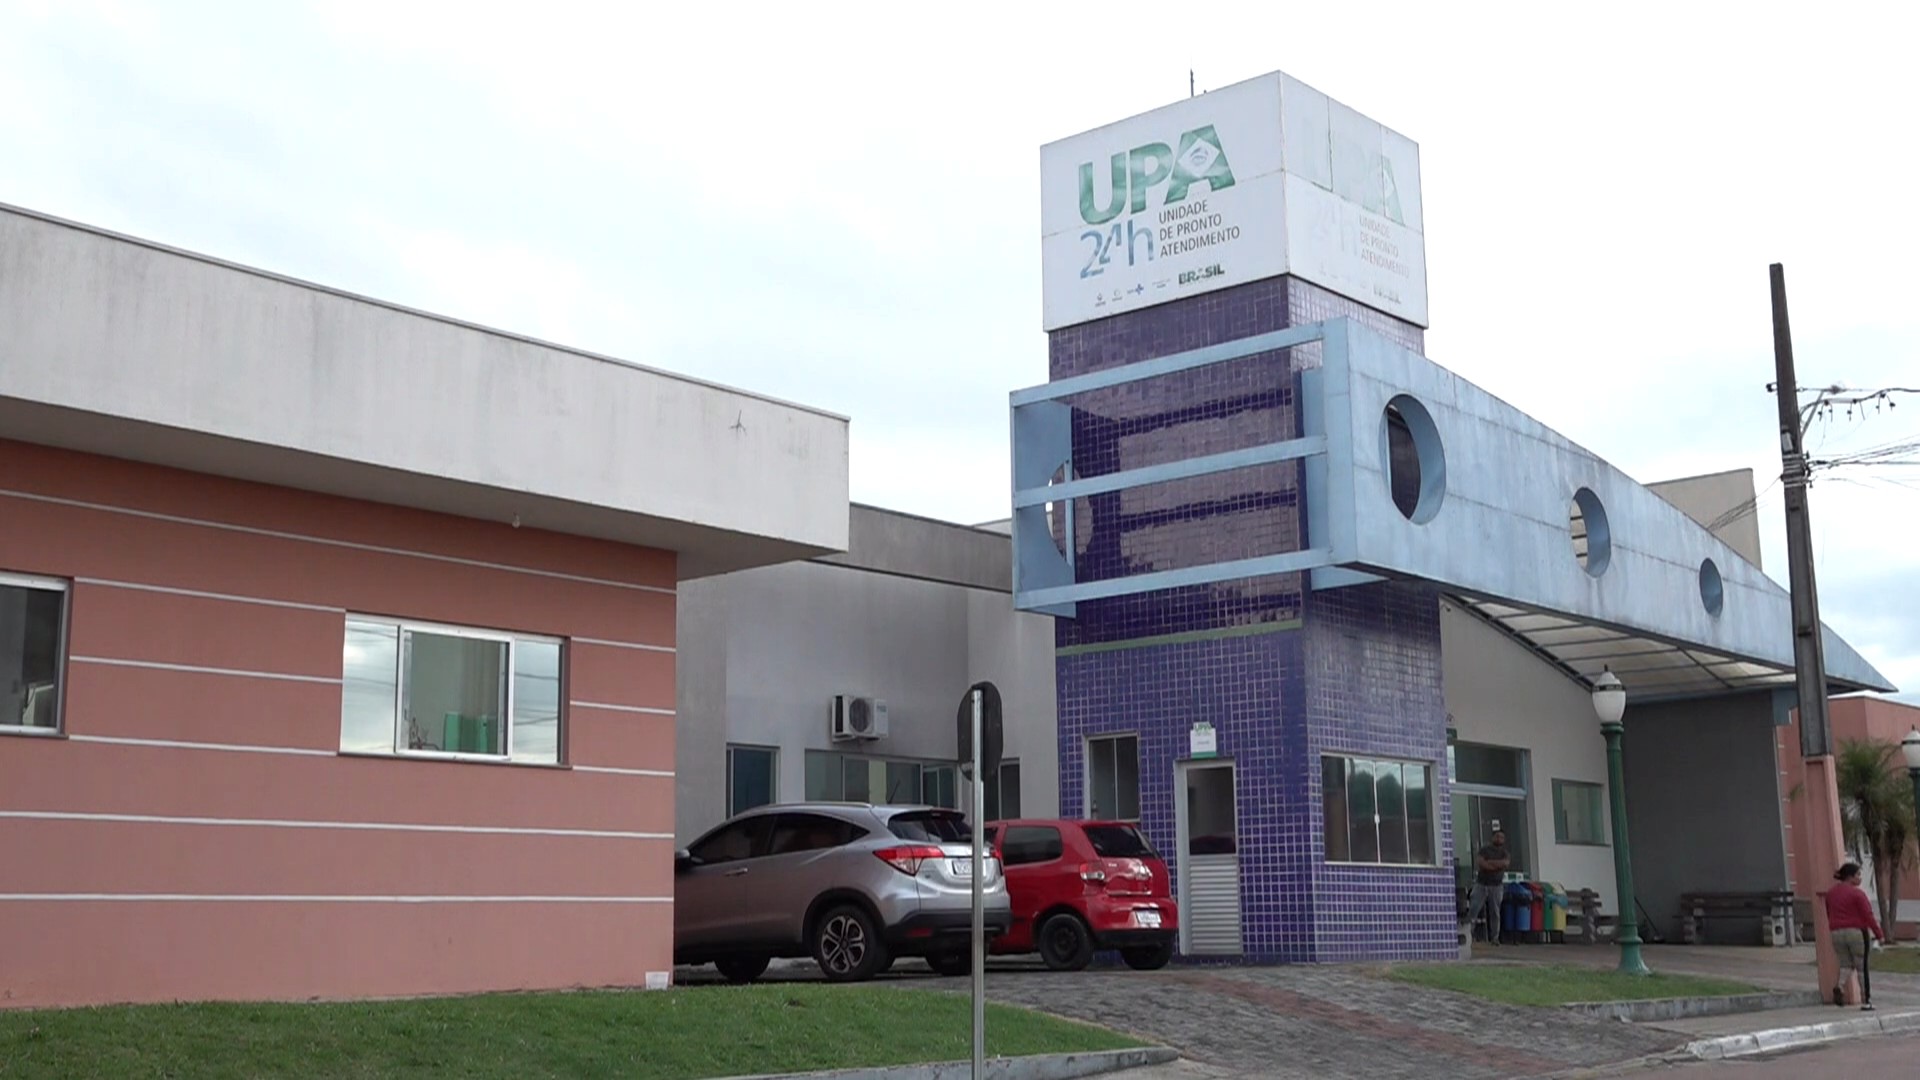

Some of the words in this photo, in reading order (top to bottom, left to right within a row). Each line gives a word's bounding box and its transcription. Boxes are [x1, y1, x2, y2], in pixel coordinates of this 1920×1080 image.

[1079, 124, 1235, 225] UPA
[1159, 200, 1208, 224] UNIDADE
[1160, 226, 1173, 241] DE
[1177, 213, 1222, 236] PRONTO
[1080, 220, 1154, 279] 24h
[1160, 226, 1240, 258] ATENDIMENTO
[1178, 263, 1225, 284] BRASIL
